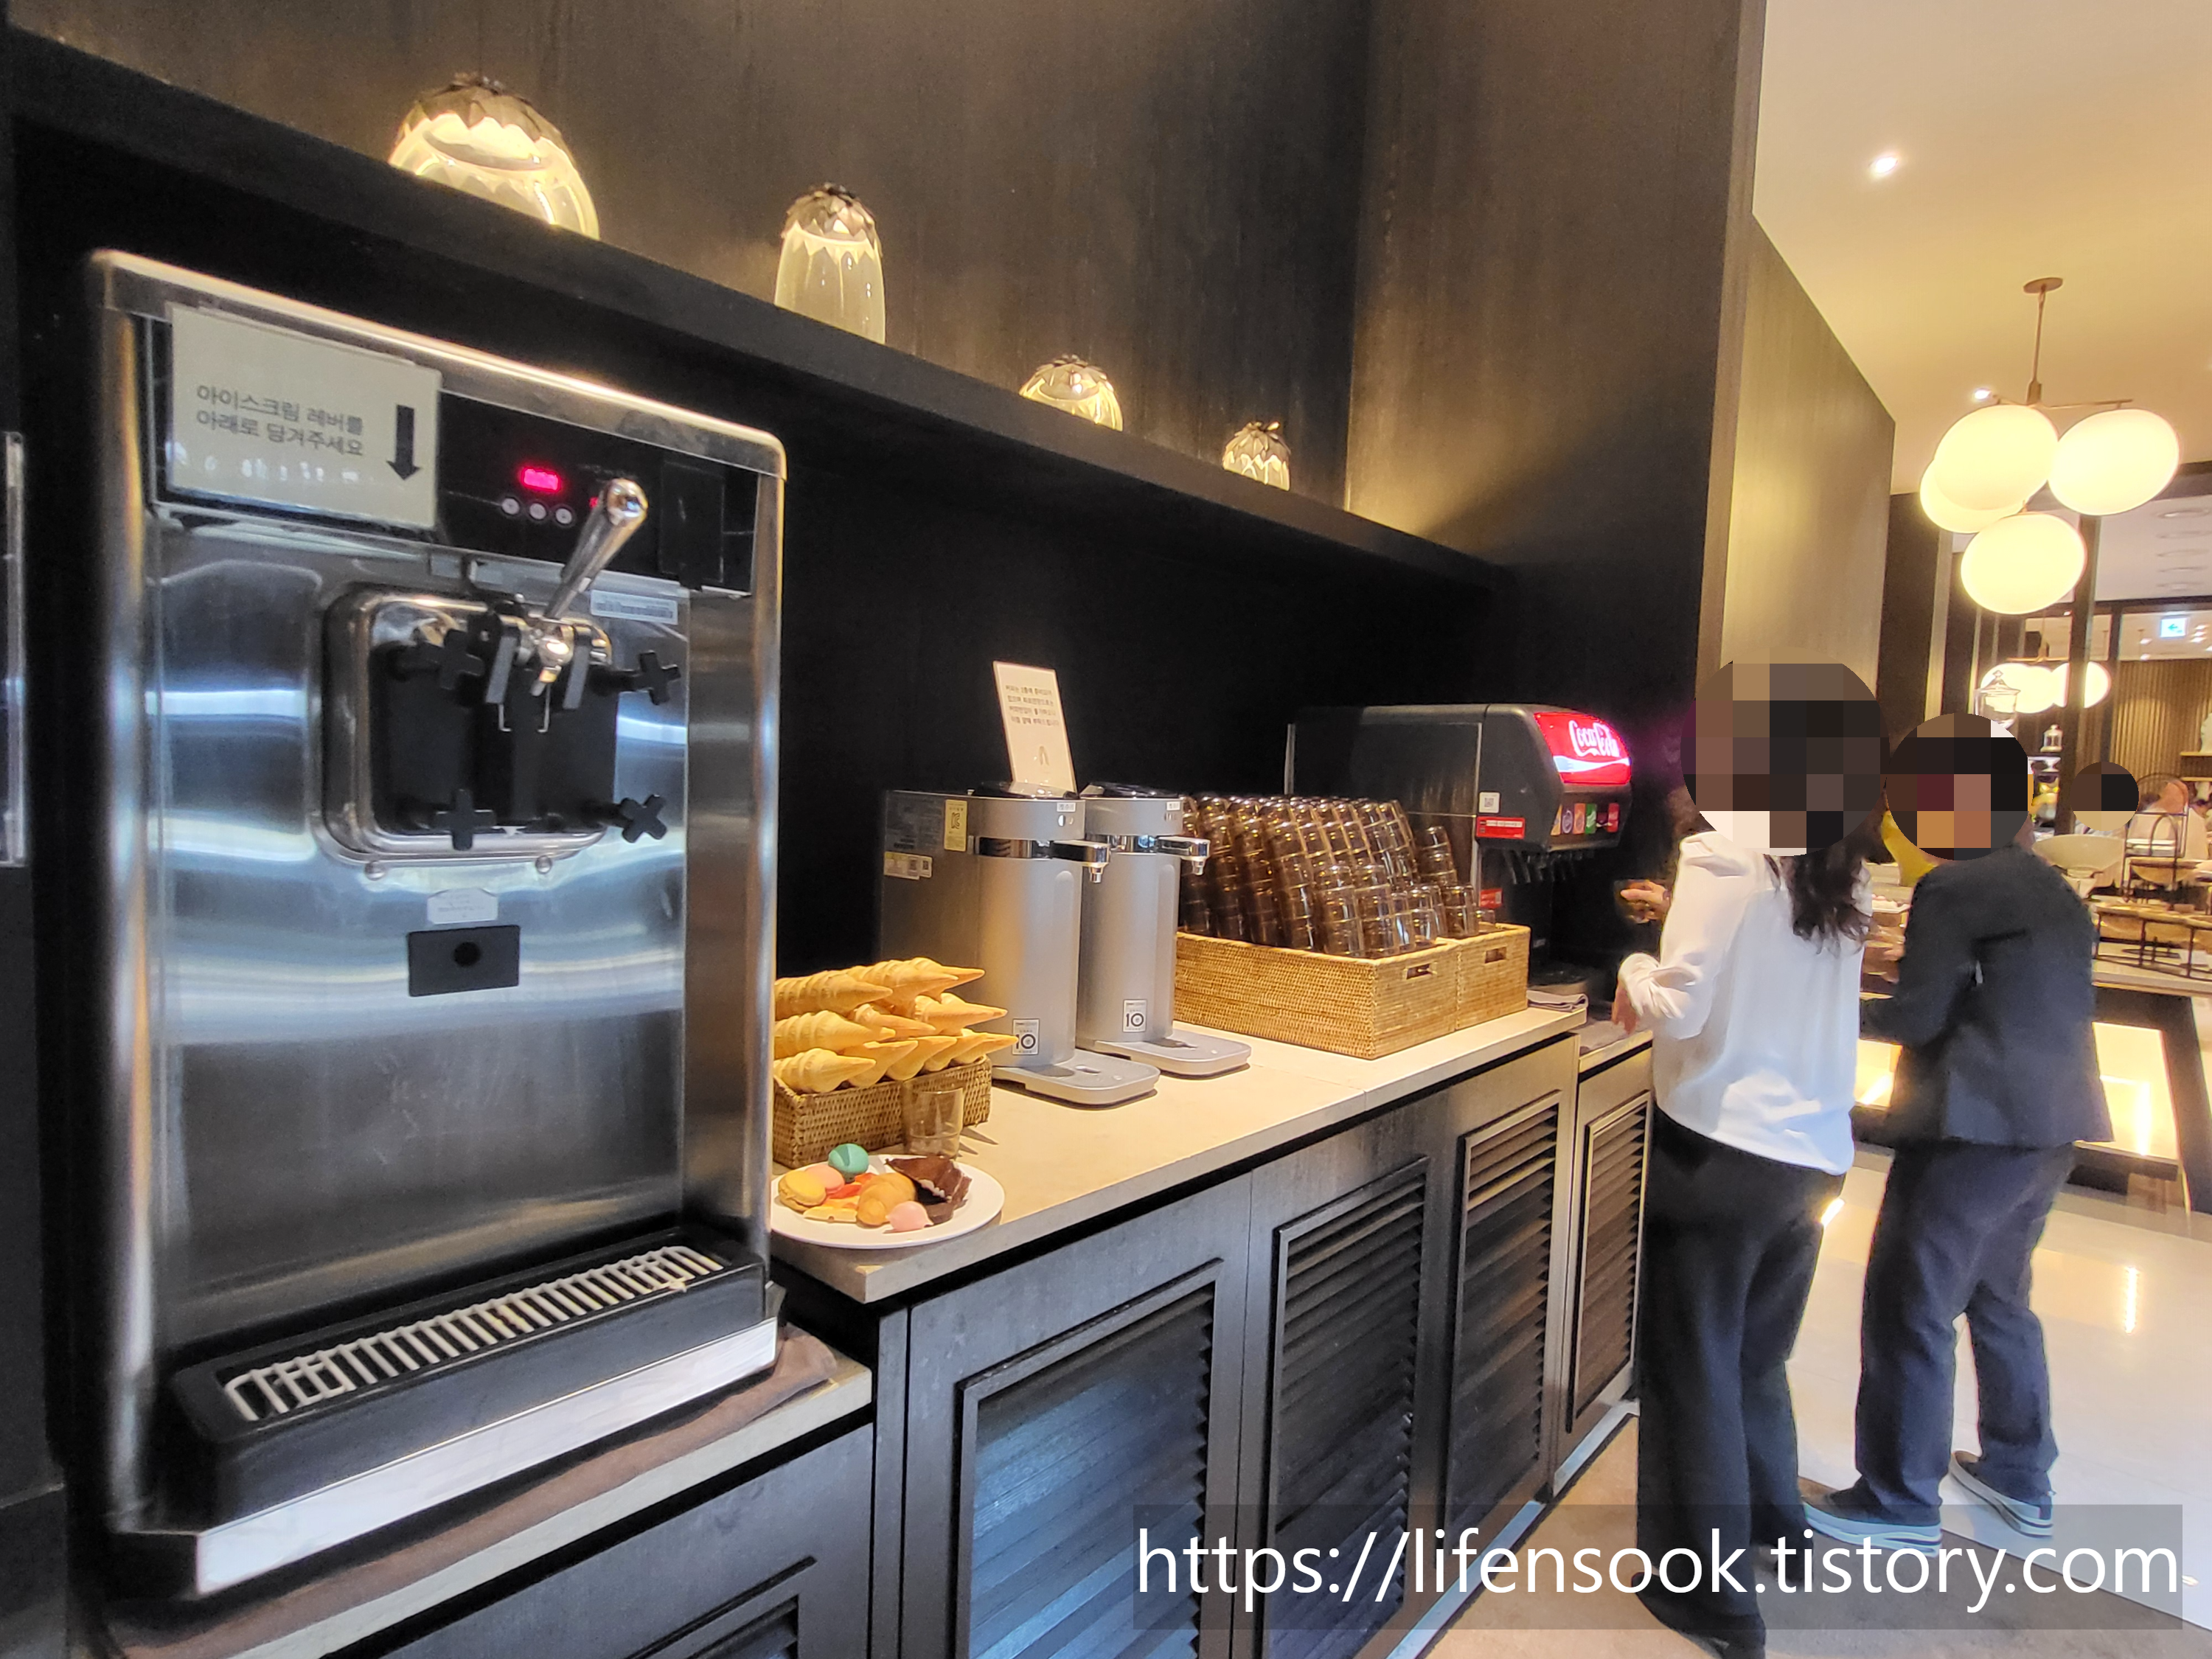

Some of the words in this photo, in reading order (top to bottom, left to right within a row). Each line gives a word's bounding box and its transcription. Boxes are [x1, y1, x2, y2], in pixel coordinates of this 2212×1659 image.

[196, 385, 299, 422] 아이스크림
[307, 408, 363, 436] 레버를
[196, 410, 260, 437] 아래로
[267, 422, 363, 456] 당겨주세요
